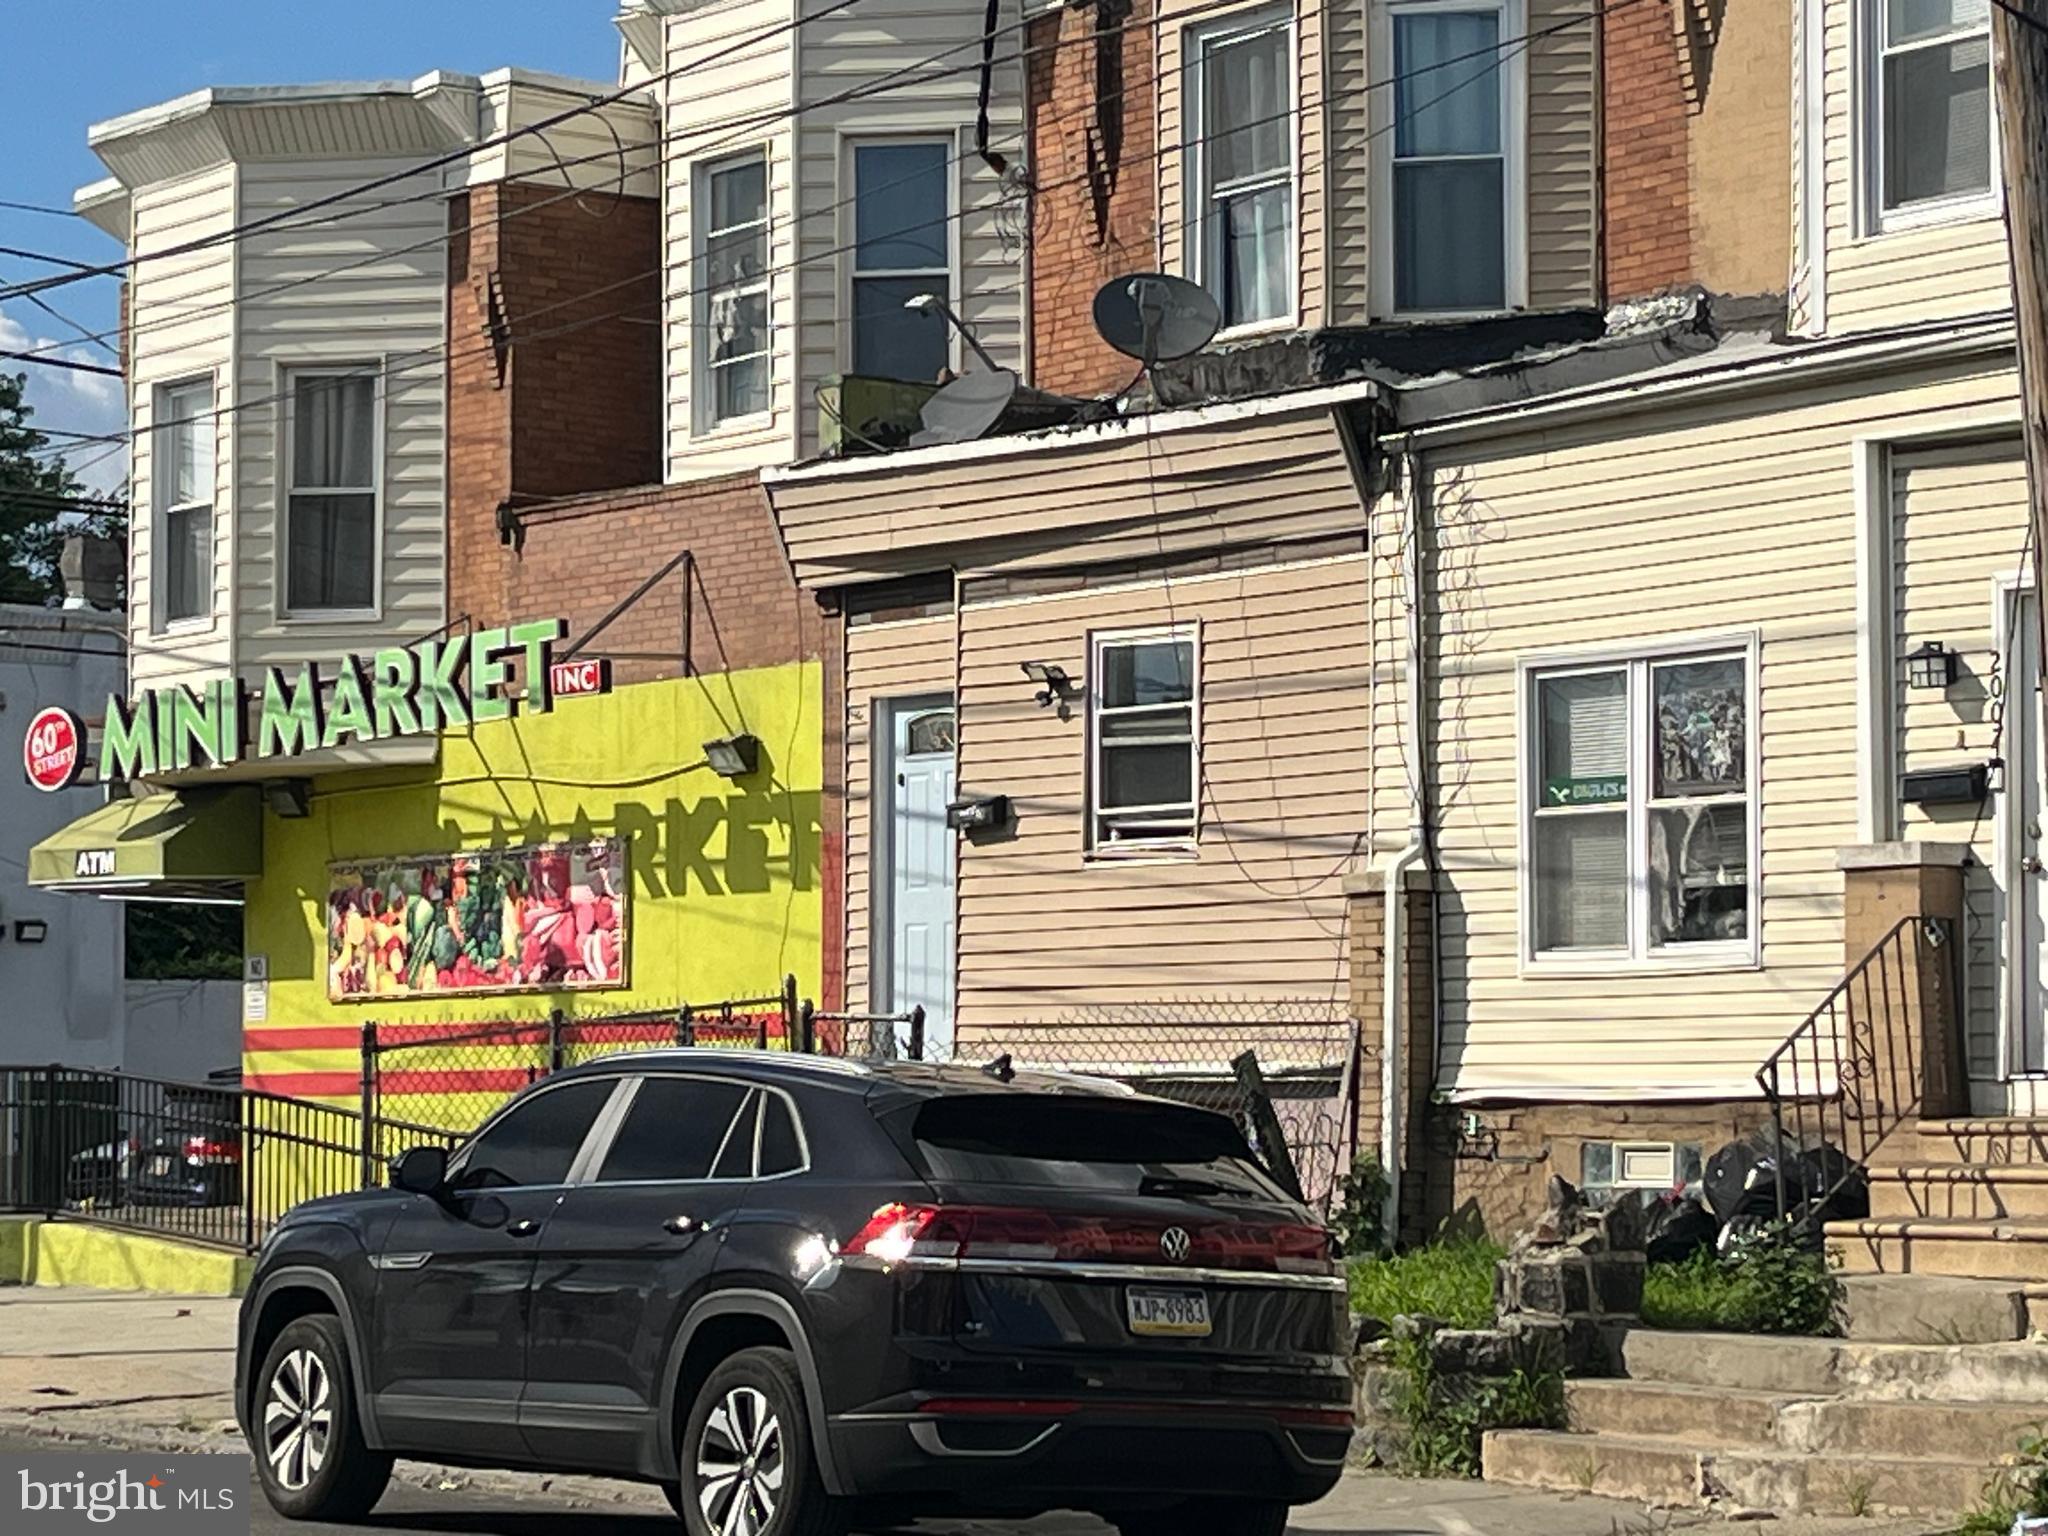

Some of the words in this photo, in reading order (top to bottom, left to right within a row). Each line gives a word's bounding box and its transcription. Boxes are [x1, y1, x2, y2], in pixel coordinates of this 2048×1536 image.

[555, 663, 597, 693] INC
[100, 676, 240, 781] MINI
[258, 618, 560, 758] MARKET
[33, 744, 75, 776] STREET
[76, 850, 116, 876] ATM
